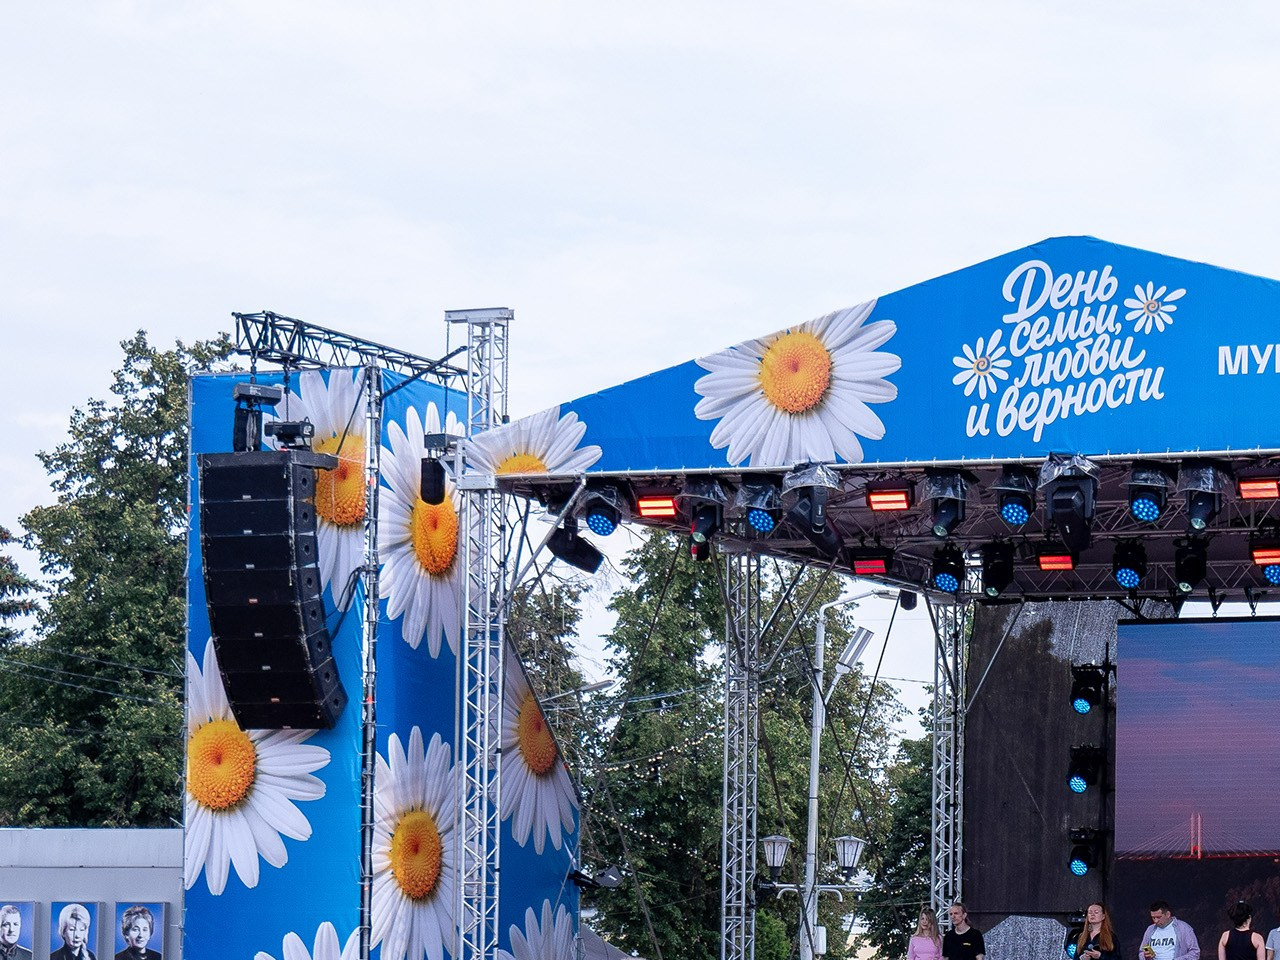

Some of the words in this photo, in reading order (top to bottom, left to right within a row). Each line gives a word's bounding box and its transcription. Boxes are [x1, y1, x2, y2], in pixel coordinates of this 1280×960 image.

[1002, 259, 1118, 323] День
[1009, 304, 1122, 357] семьи,
[1014, 333, 1146, 388] любви
[966, 403, 990, 438] и
[996, 367, 1165, 443] верности
